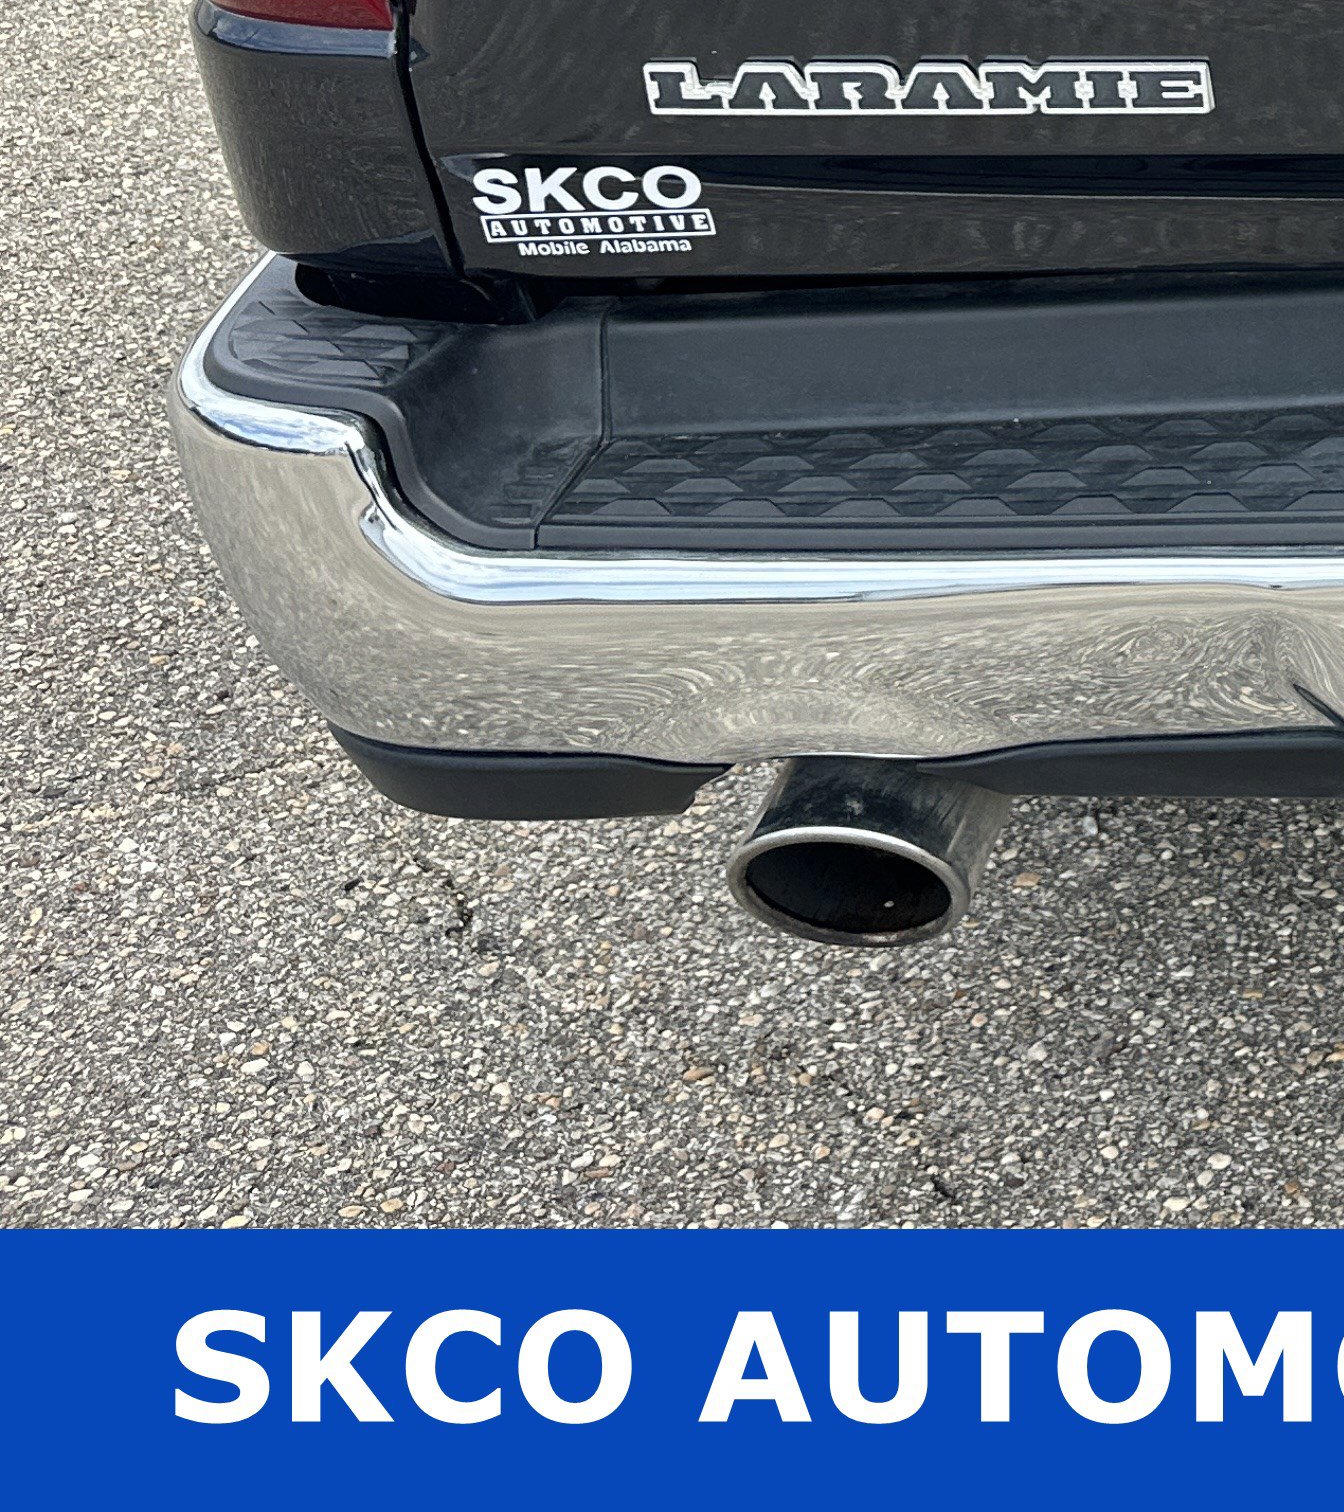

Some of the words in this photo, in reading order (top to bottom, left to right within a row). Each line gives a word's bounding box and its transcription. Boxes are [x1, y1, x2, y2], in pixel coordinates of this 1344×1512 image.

[643, 57, 1215, 115] LARAMIE
[472, 165, 702, 215] SKCO
[490, 214, 710, 238] AUTOMOTIVE
[518, 241, 590, 256] Mobile
[599, 239, 692, 255] Alabama
